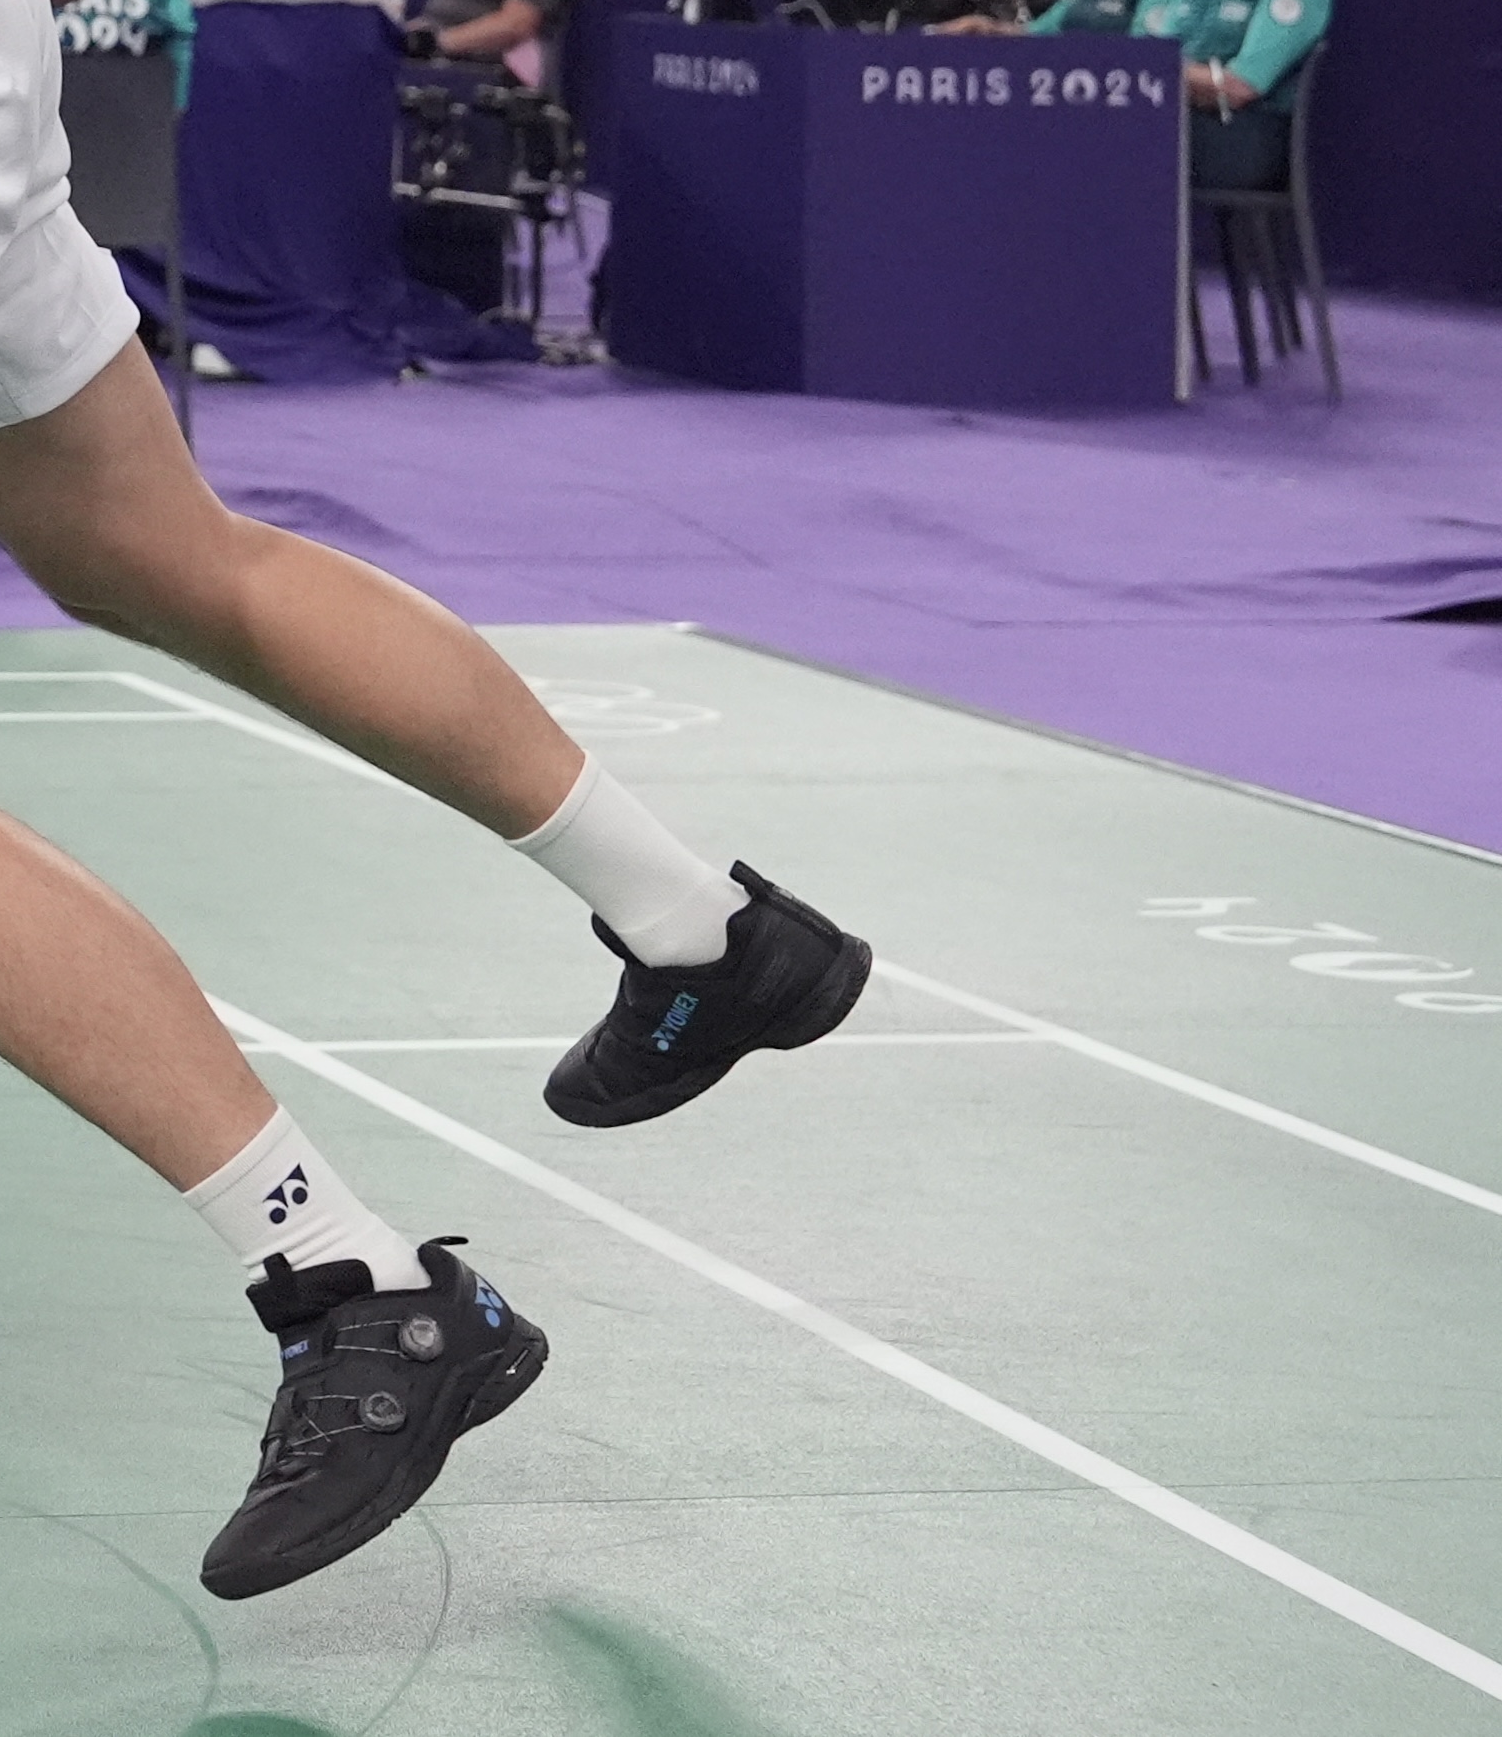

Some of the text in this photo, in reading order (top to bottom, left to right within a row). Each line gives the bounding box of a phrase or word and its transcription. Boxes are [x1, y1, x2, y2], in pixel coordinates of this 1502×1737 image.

[862, 65, 1165, 108] PARIS 2024
[663, 990, 700, 1034] YONEX
